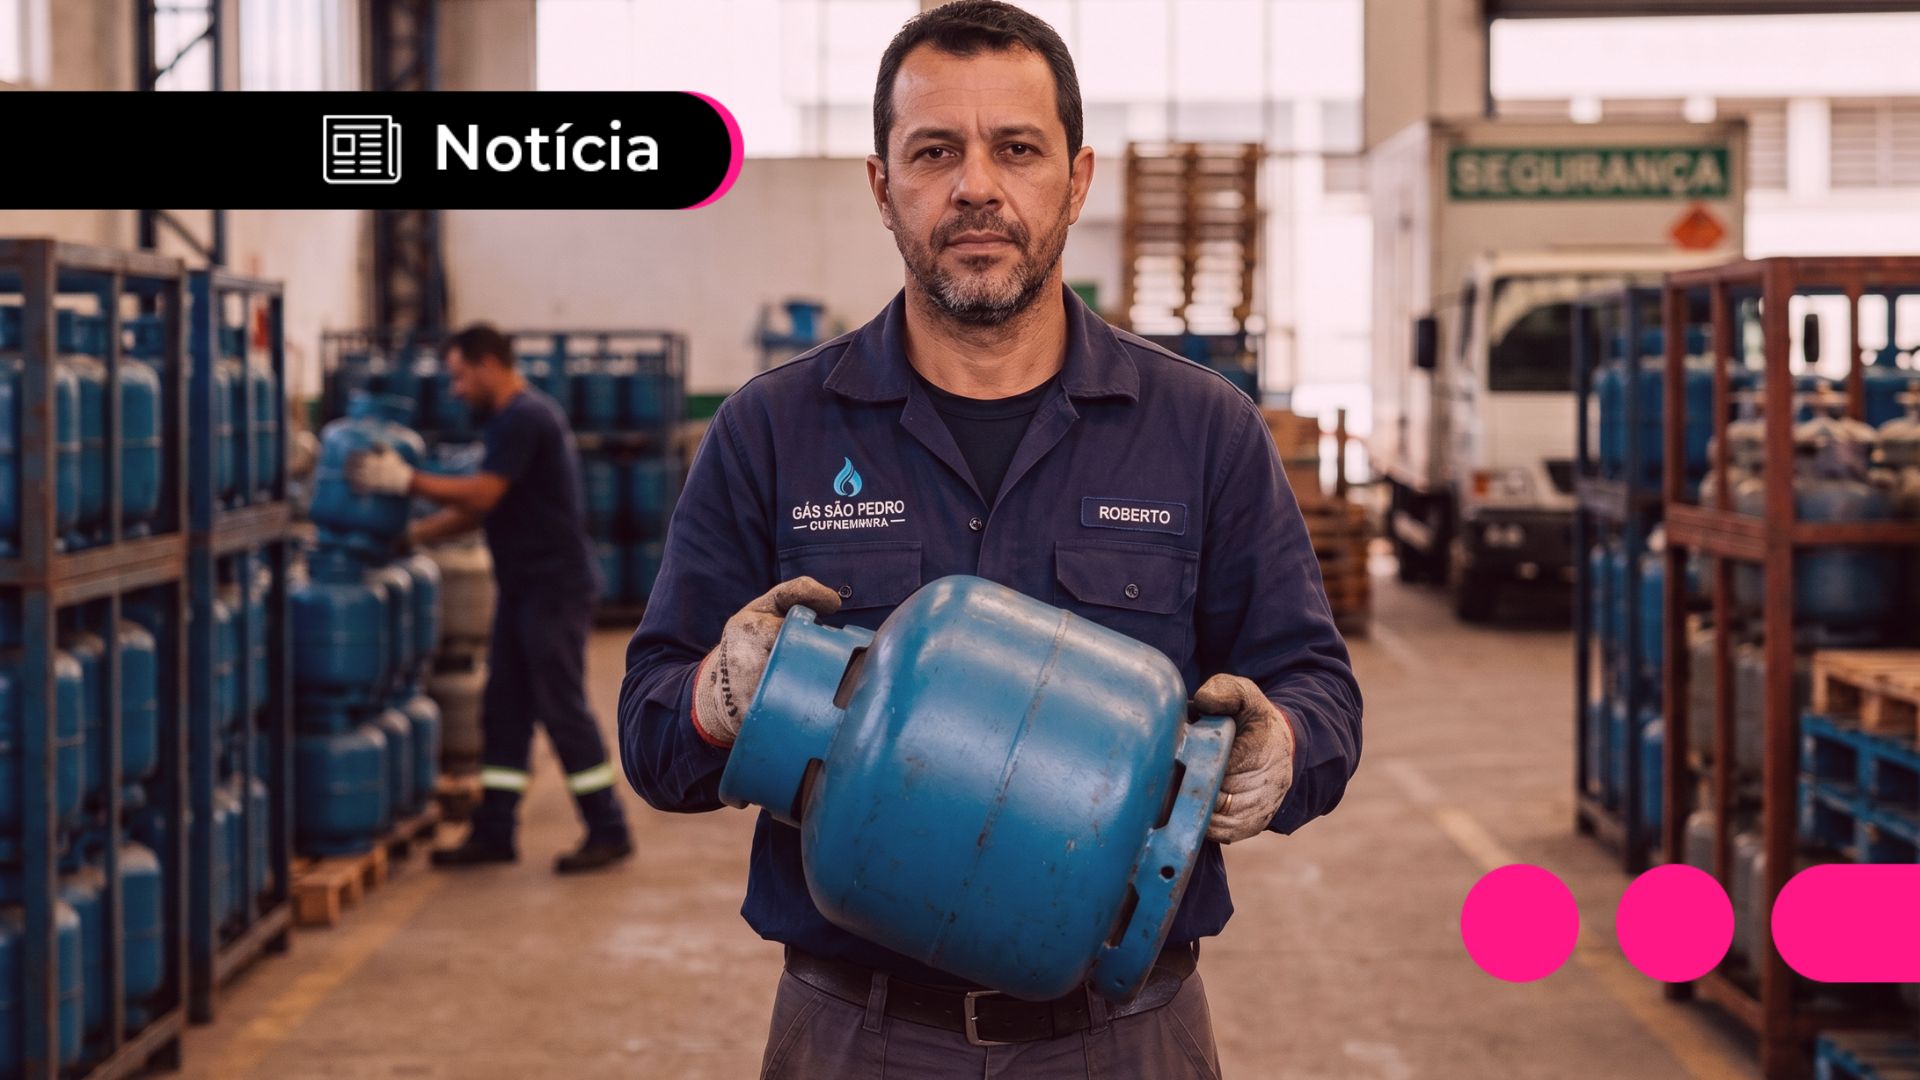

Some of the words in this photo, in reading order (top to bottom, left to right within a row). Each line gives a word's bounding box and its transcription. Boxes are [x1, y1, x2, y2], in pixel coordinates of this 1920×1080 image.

[1454, 151, 1724, 198] SEGURANÇA
[792, 501, 821, 520] GÁS
[824, 500, 854, 518] SÃO
[857, 499, 905, 516] PEDRO
[1099, 505, 1171, 524] ROBERTO
